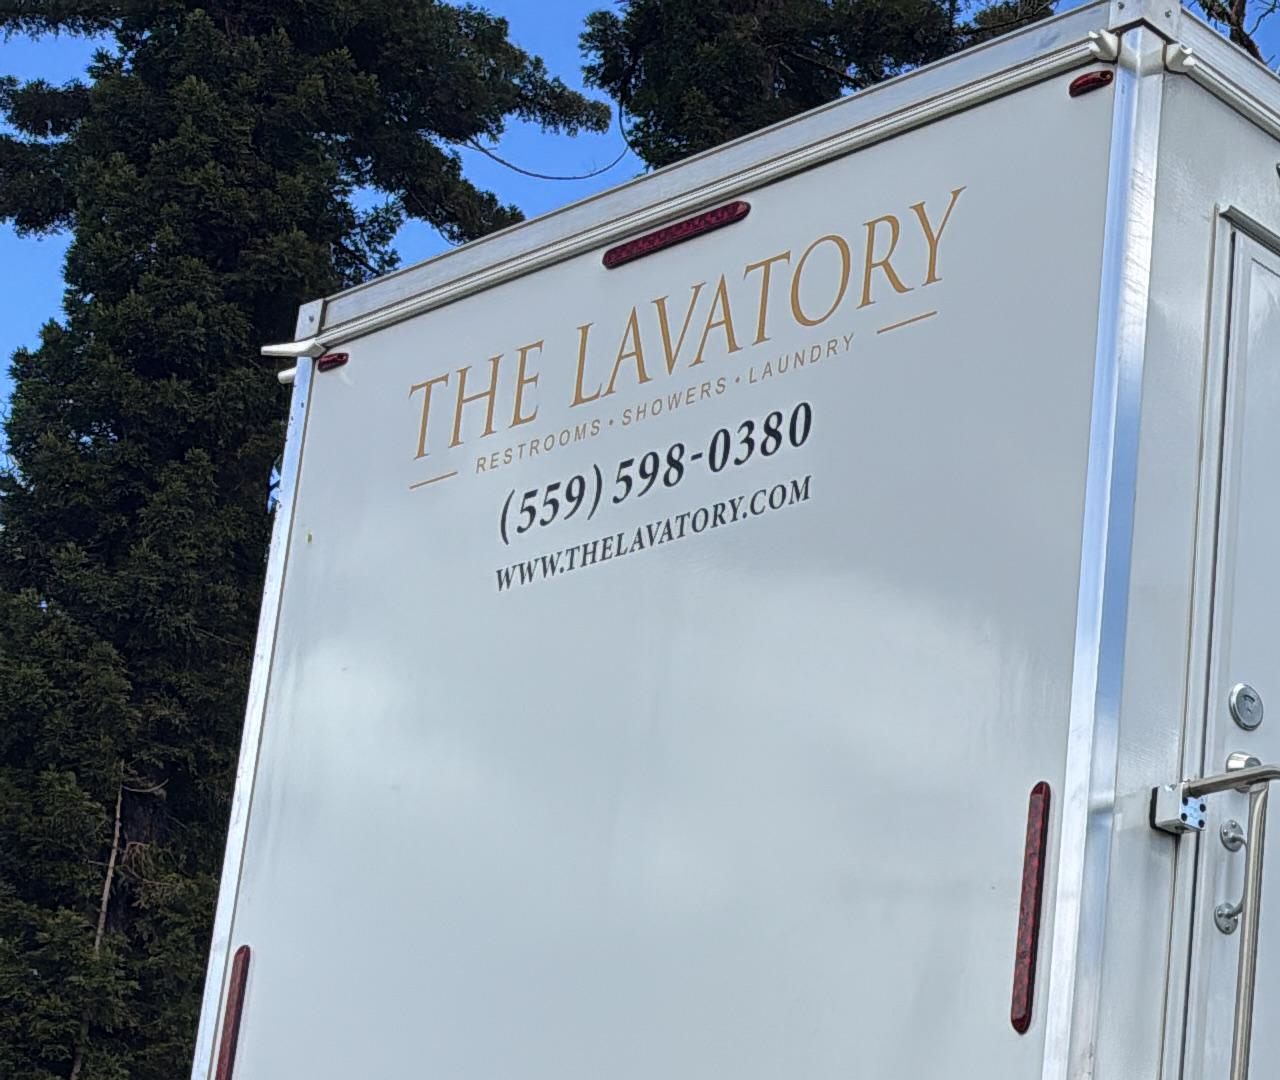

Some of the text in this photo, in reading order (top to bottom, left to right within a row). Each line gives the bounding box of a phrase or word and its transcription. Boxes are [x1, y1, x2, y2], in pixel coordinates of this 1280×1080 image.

[408, 186, 968, 461] THE LAVATORY
[475, 333, 856, 474] RESTROOMS SHOWERS LAUNDRY
[499, 401, 813, 545] (559) 598-0380
[494, 475, 813, 592] WWW.THELAVATORY.COM
